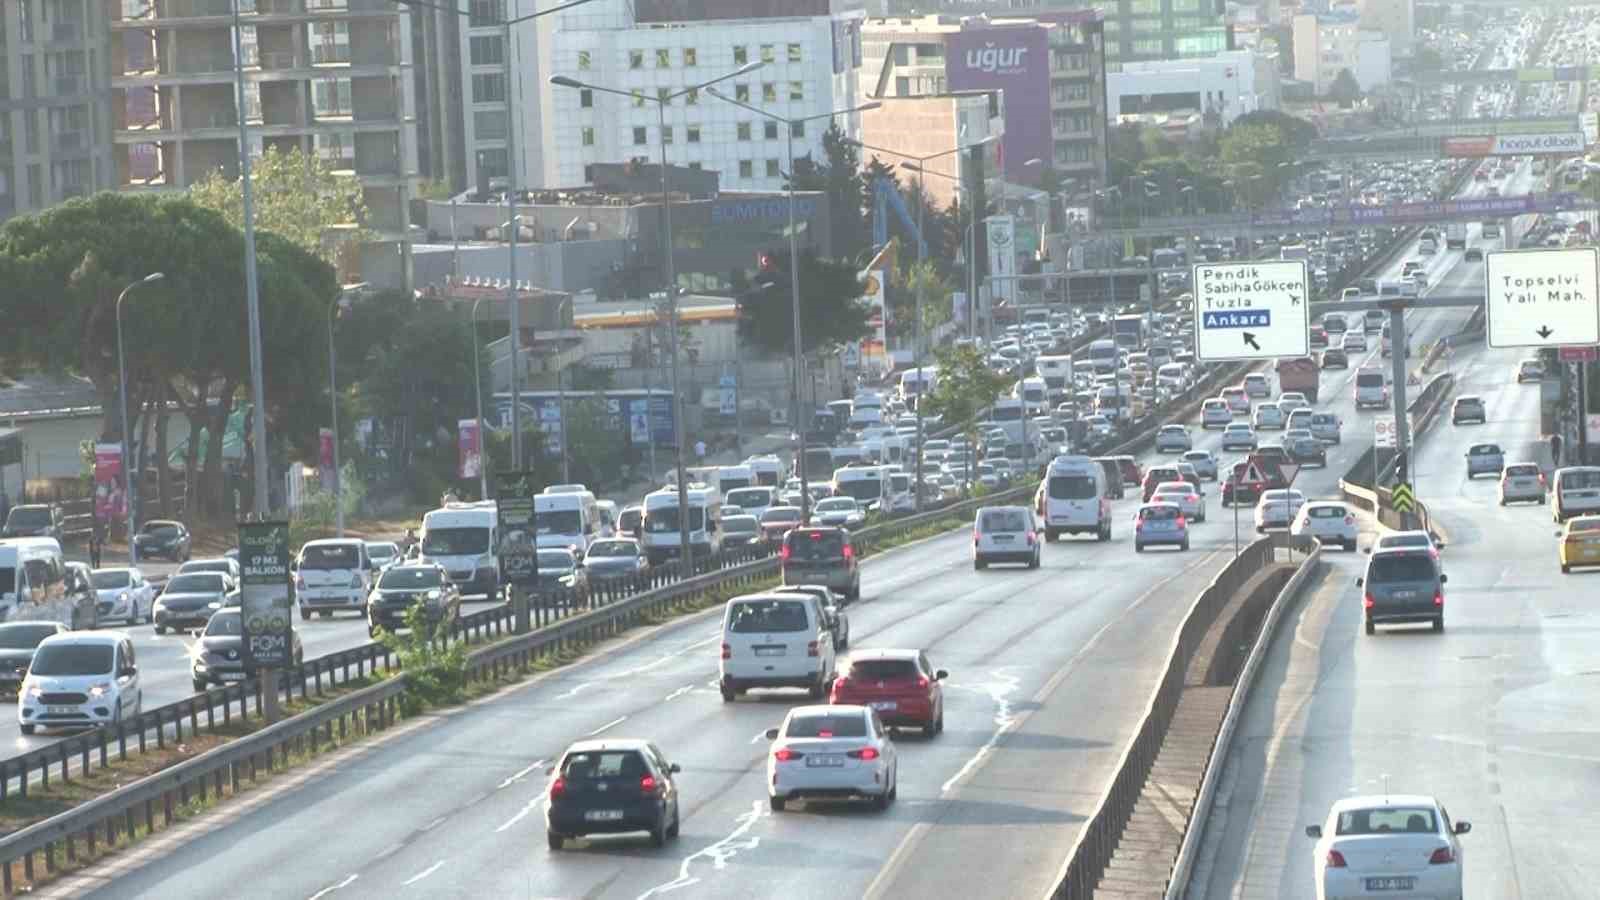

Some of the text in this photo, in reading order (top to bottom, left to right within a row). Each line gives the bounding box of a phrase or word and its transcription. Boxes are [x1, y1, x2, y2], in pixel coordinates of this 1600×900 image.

[966, 41, 1028, 72] uğur
[1203, 267, 1259, 280] Pendik
[1204, 279, 1303, 294] Sabiha Gökçen
[1503, 273, 1579, 290] Topselvi
[1205, 297, 1252, 308] Tuzla
[1547, 289, 1587, 303] Mah.
[1207, 313, 1268, 327] Ankara
[244, 565, 286, 577] BALKON
